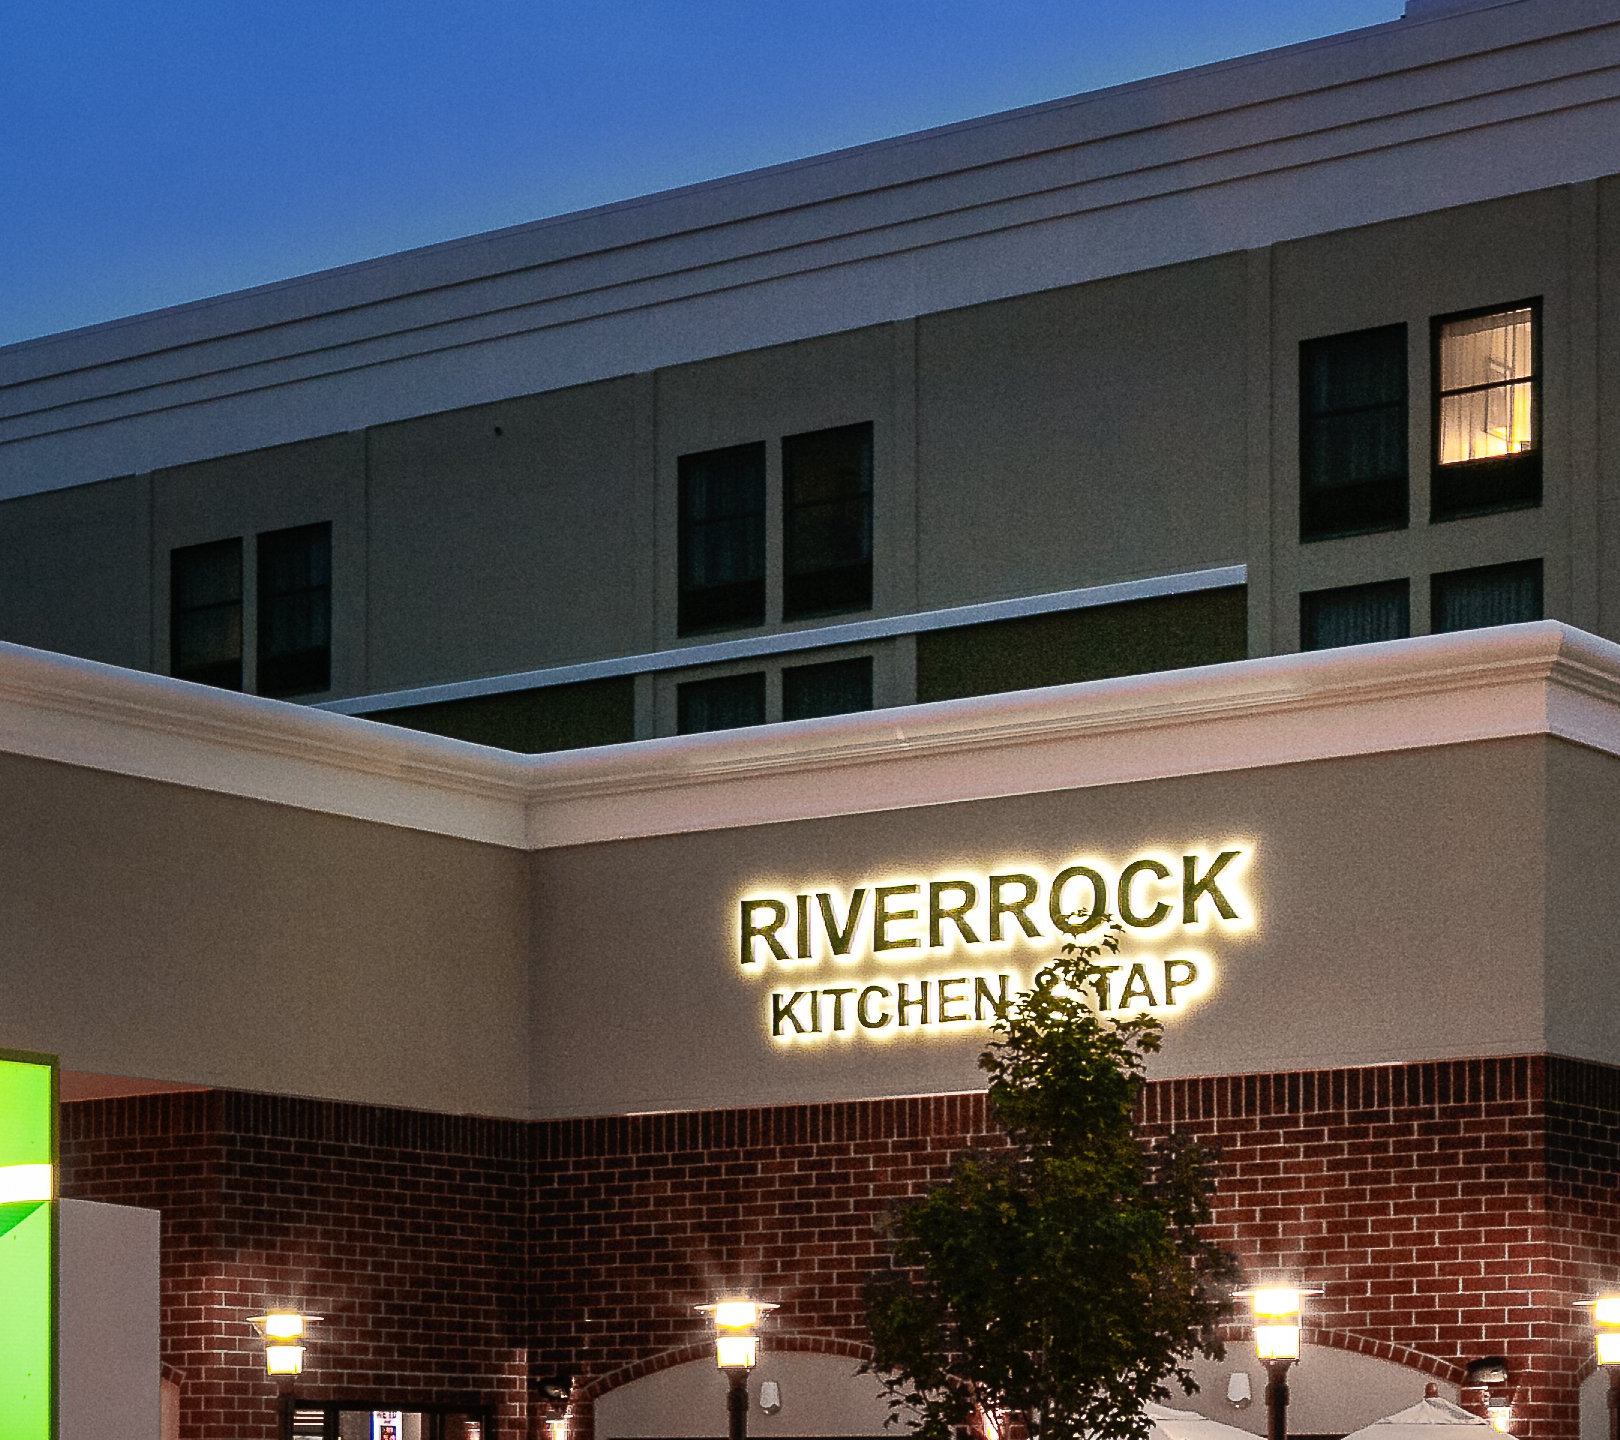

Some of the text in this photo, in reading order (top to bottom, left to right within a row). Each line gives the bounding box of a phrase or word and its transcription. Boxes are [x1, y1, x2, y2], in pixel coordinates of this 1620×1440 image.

[739, 850, 1242, 963] RIVERROCK
[771, 975, 1009, 1036] KITCHEN
[1088, 959, 1199, 1012] TAP
